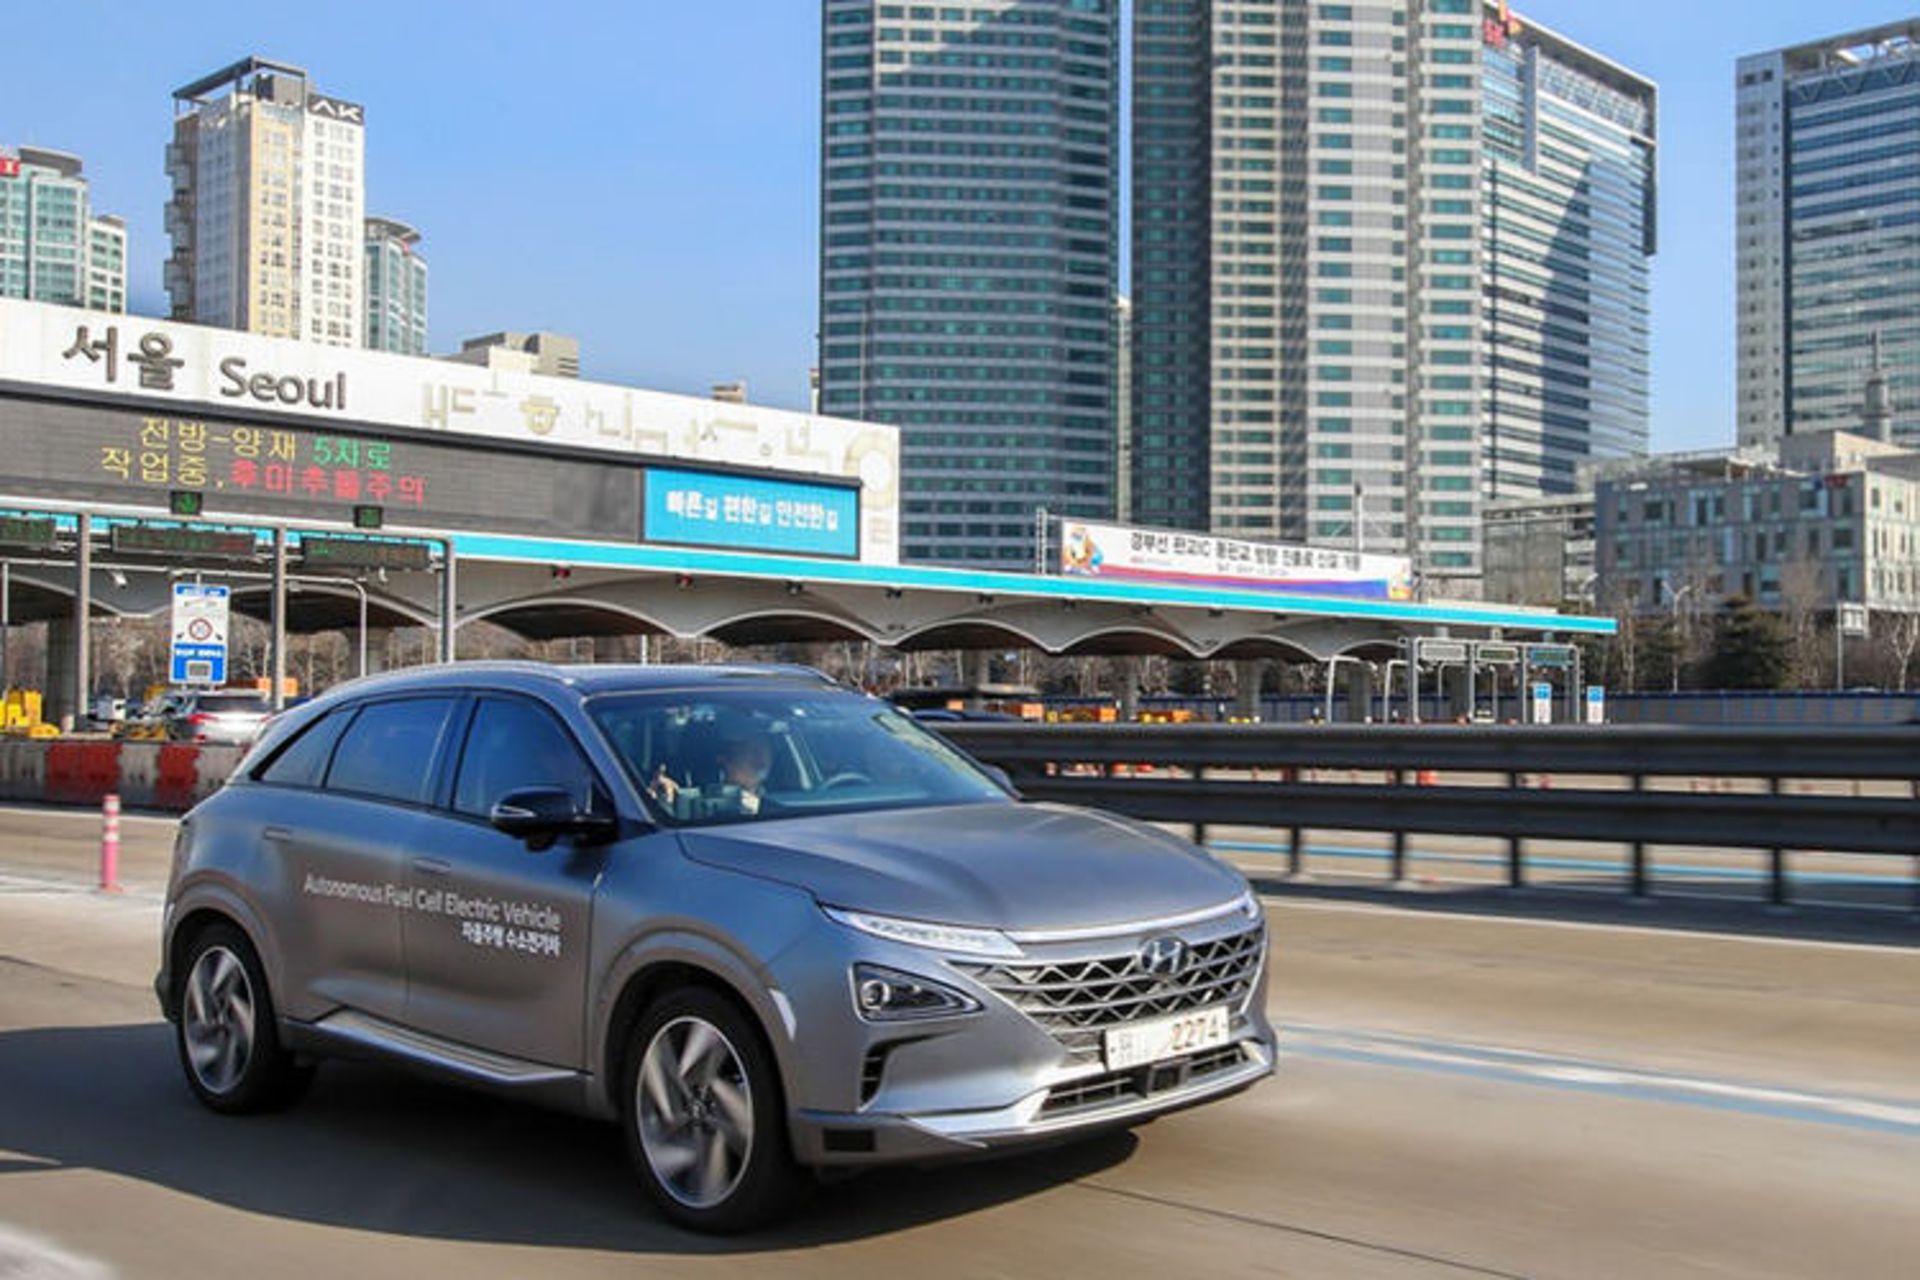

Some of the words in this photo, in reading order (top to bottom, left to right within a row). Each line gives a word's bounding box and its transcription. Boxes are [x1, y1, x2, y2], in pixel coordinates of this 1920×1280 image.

[311, 99, 360, 121] AK
[62, 325, 184, 391] 서울
[219, 355, 347, 411] Seoul
[312, 435, 392, 470] 5차로
[304, 872, 383, 902] Autonomous
[386, 884, 413, 907] Fuel
[416, 889, 442, 912] Cell
[446, 892, 500, 921] Electric
[502, 901, 560, 931] Vehicle
